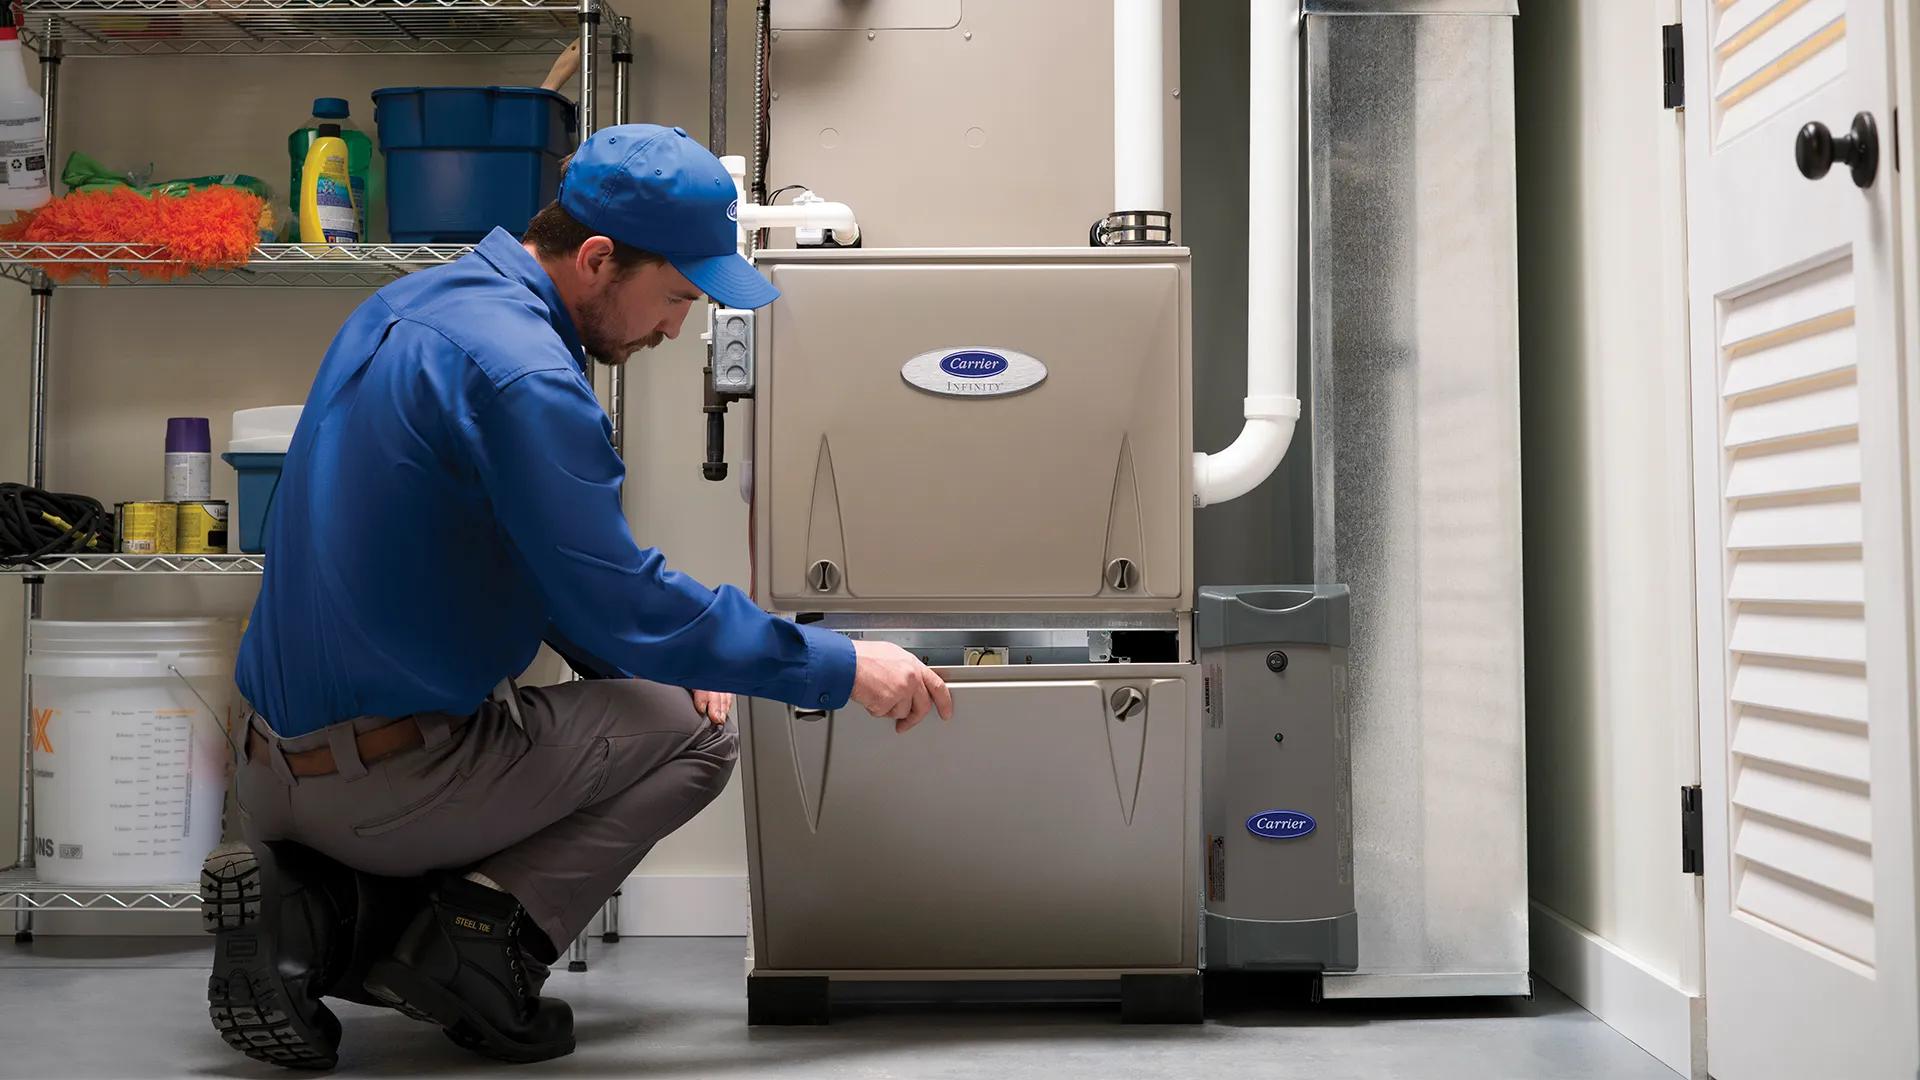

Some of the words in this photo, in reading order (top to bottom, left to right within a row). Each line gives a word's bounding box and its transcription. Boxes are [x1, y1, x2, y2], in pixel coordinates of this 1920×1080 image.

[950, 357, 1000, 370] Carrier
[947, 381, 1002, 392] INFINITY
[1257, 817, 1307, 830] Carrier
[455, 916, 477, 930] STEEL
[479, 922, 491, 933] TOE
